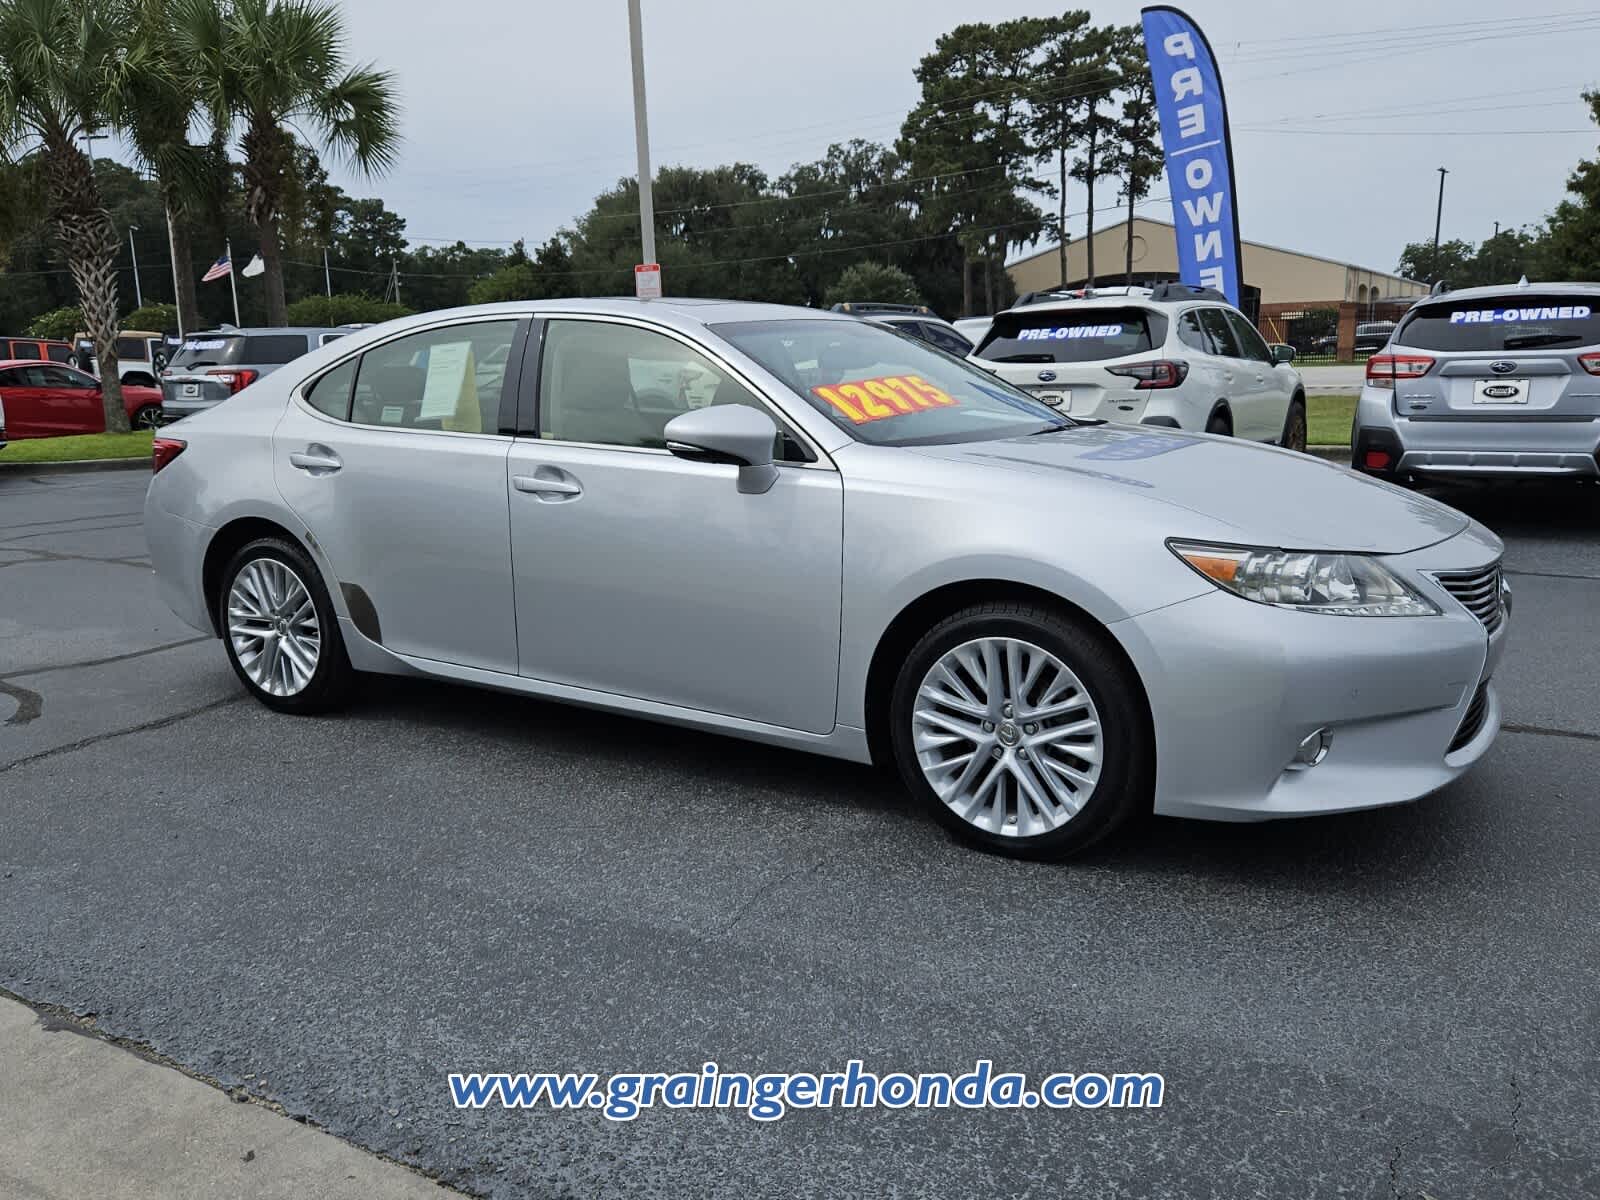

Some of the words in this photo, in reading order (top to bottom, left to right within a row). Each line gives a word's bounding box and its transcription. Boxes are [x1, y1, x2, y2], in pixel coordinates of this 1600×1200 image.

[1450, 305, 1591, 323] PRE-OWNED
[1017, 324, 1122, 341] PRE-OWNED
[812, 375, 958, 424] 12975
